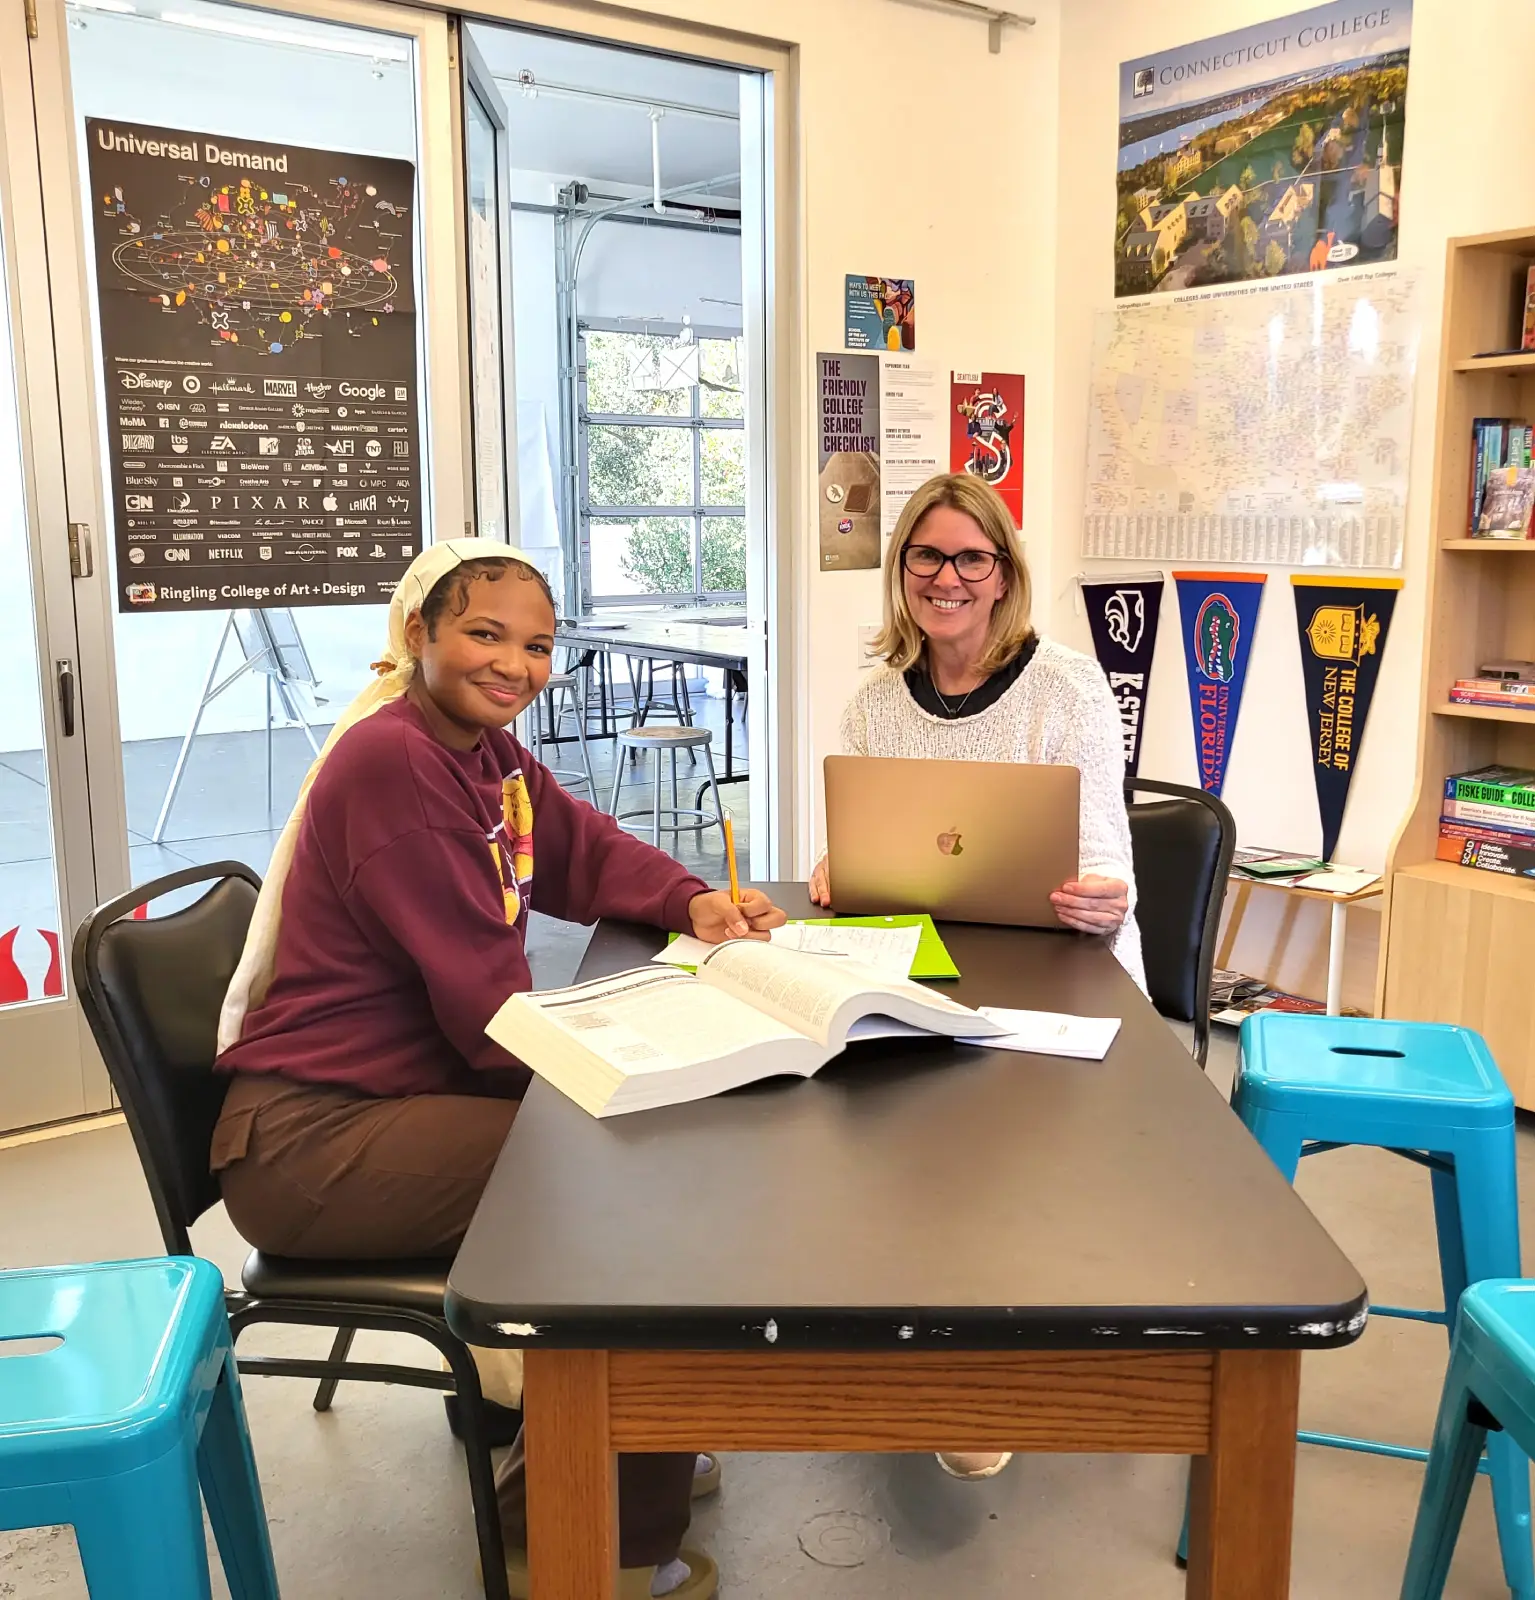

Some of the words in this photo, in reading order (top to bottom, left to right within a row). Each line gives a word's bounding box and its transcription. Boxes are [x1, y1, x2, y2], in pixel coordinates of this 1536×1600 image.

[1160, 36, 1291, 86] CONNECTICUT
[1298, 8, 1391, 48] COLLEGE
[98, 128, 198, 162] Universal
[206, 144, 288, 172] Demand
[1174, 294, 1198, 304] COLLEGES
[1212, 289, 1248, 298] UNIVERSITIES
[1270, 284, 1292, 292] UNITED
[1293, 280, 1314, 289] STATES
[822, 360, 840, 377] THE
[208, 382, 256, 395] Hallmark
[264, 380, 296, 396] MARVEL
[339, 382, 386, 400] Google
[822, 379, 867, 397] FRIENDLY
[164, 402, 180, 411] IGN
[823, 398, 864, 416] COLLEGE
[120, 418, 146, 426] MoMA
[220, 421, 268, 430] nickelodeon
[824, 417, 862, 434] SEARCH
[122, 435, 155, 450] BLIZZARD
[171, 435, 188, 444] tbs
[210, 436, 236, 450] EA
[334, 440, 354, 454] AFI
[394, 441, 409, 454] FELD
[824, 436, 876, 452] CHECKLIST
[126, 476, 144, 485] Blue
[144, 476, 159, 486] Sky
[126, 495, 153, 509] CN
[350, 495, 377, 511] LAIKA
[387, 495, 409, 512] Ogilvy
[173, 519, 198, 527] amazon
[164, 549, 190, 561] CNN
[208, 549, 244, 560] NETFLIX
[336, 547, 359, 558] FOX
[160, 587, 217, 602] Ringling
[221, 584, 270, 600] College
[274, 584, 287, 596] of
[290, 583, 310, 596] Art
[311, 586, 319, 595] +
[323, 582, 366, 597] Design
[1322, 666, 1338, 710] NEW
[1340, 668, 1357, 694] THE
[1110, 672, 1144, 763] K-STATE
[1335, 696, 1354, 751] COLLEGE
[1215, 686, 1229, 768] UNIVERSITY
[1199, 683, 1217, 790] FLORIDA
[1318, 709, 1334, 769] JERSEY
[1334, 753, 1349, 771] OF
[1458, 784, 1480, 799] FISKE
[1482, 787, 1504, 802] GUIDE
[1462, 840, 1474, 864] SCAD
[1479, 850, 1509, 860] Innovate.
[1480, 843, 1503, 852] Ideate.
[1476, 862, 1516, 874] Collaborate.
[1477, 856, 1501, 865] Create.
